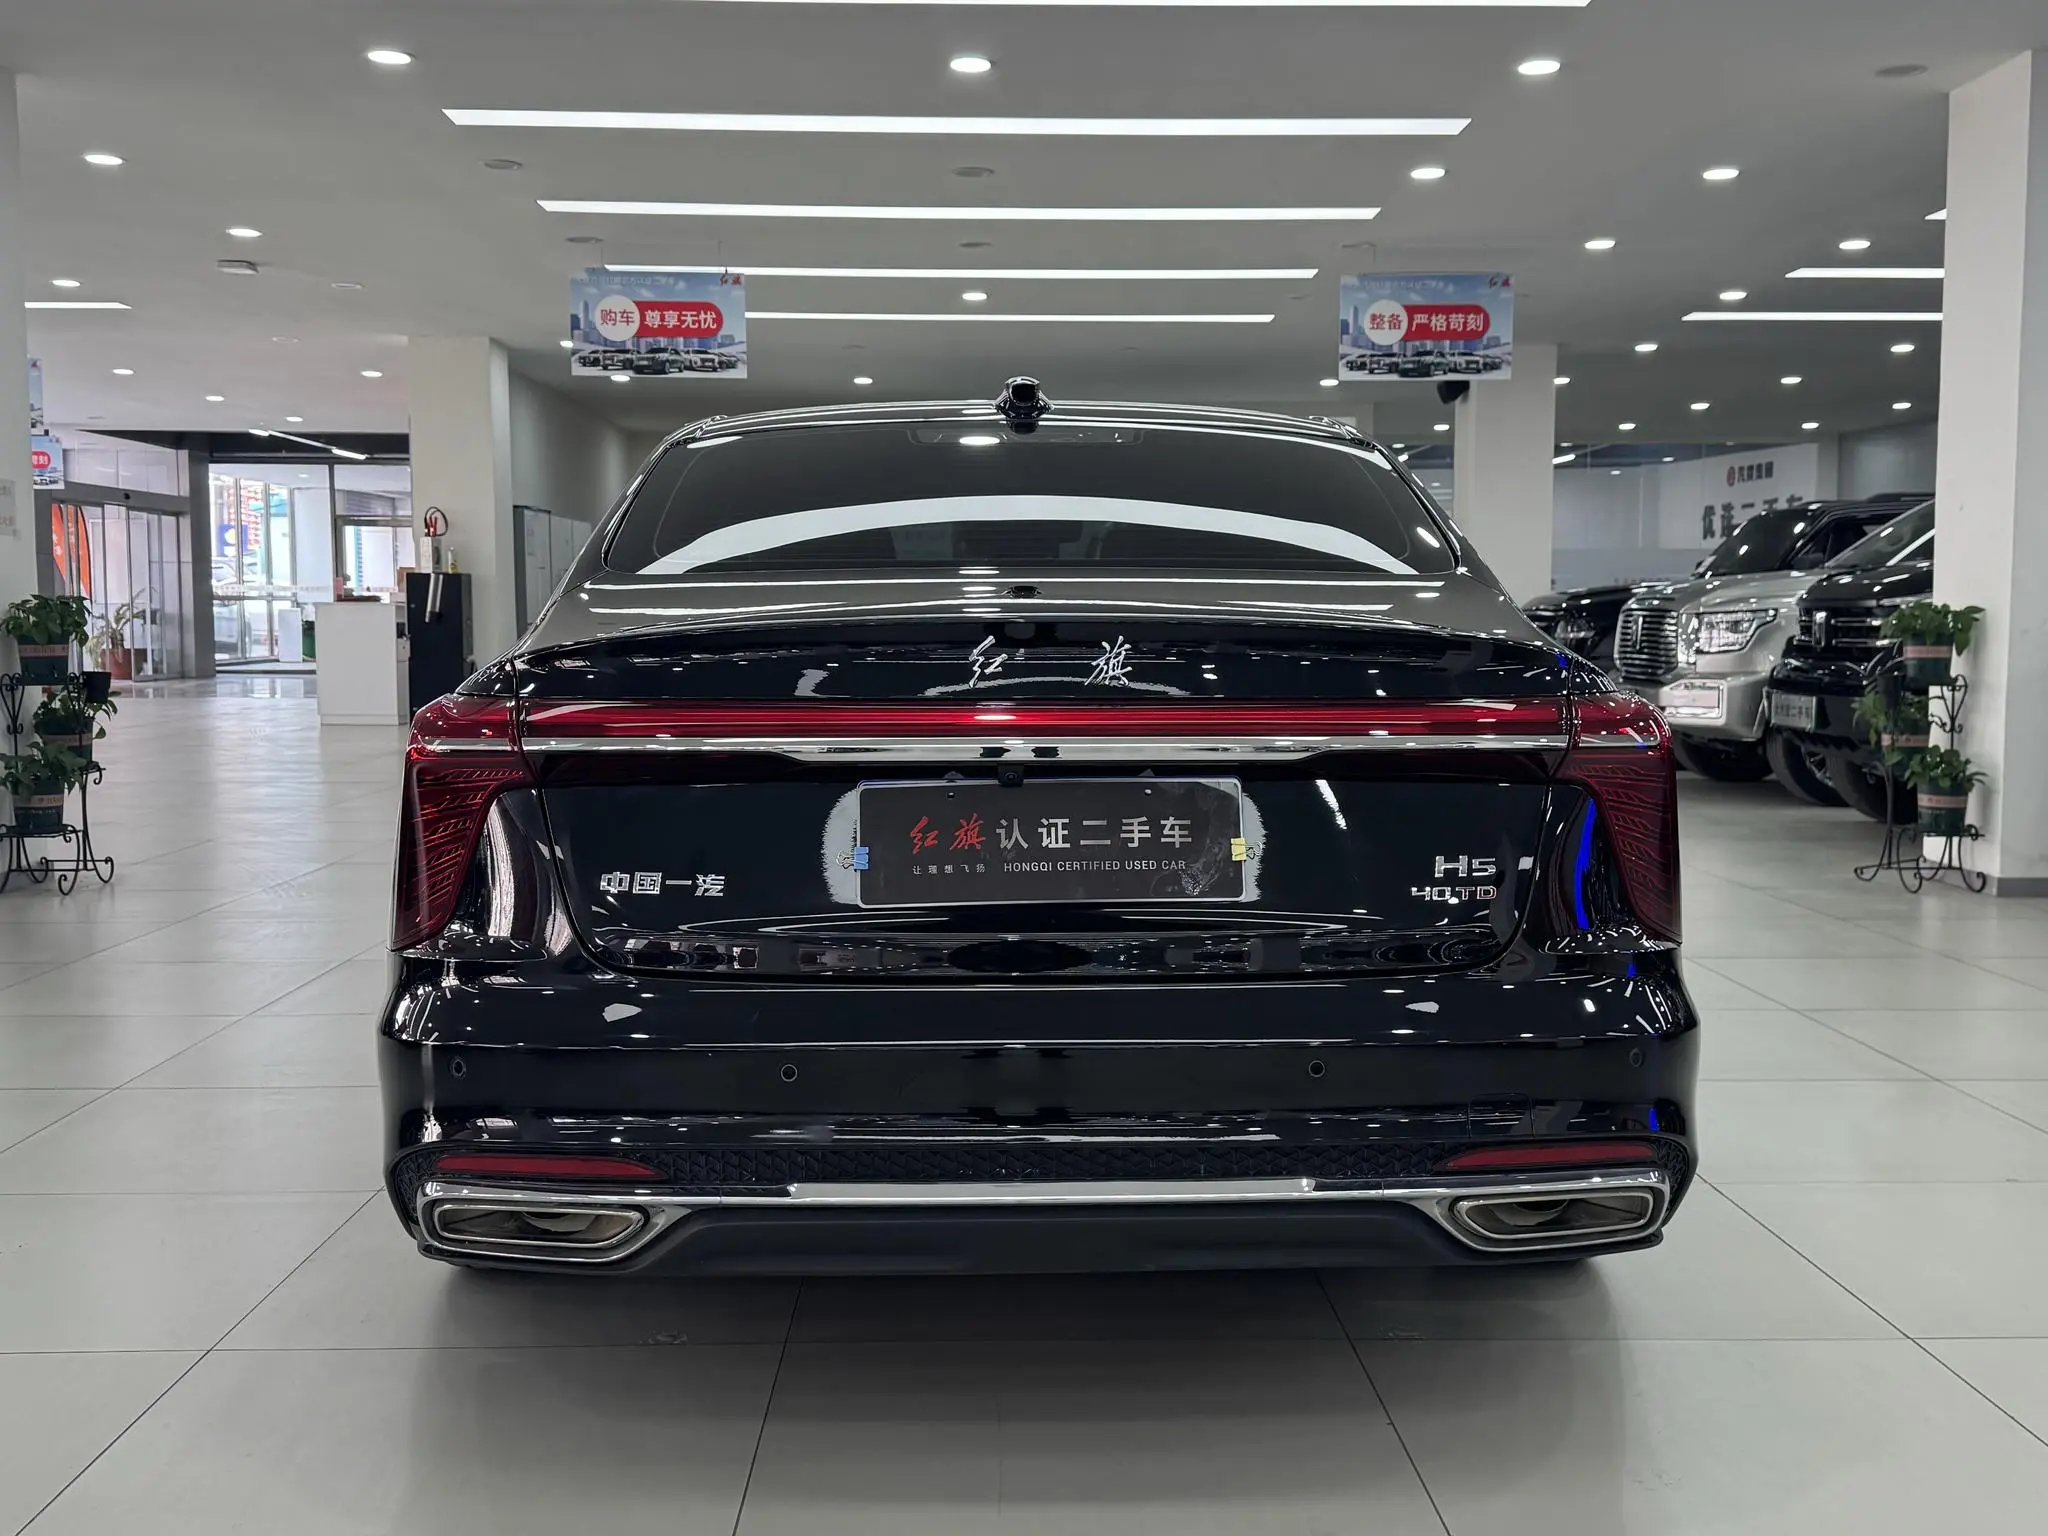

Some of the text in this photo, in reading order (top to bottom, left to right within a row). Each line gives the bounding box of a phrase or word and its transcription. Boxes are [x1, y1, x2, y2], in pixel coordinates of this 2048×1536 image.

[600, 308, 718, 329] 购车 尊享无忧
[1369, 313, 1484, 332] 整备 严格苛刻
[969, 635, 1133, 688] 红旗
[912, 863, 985, 875] 让理想飞扬
[1004, 860, 1186, 872] HONGQI CERTIFIED USED CAR
[1434, 855, 1497, 878] H5
[600, 871, 725, 897] 中国一汽
